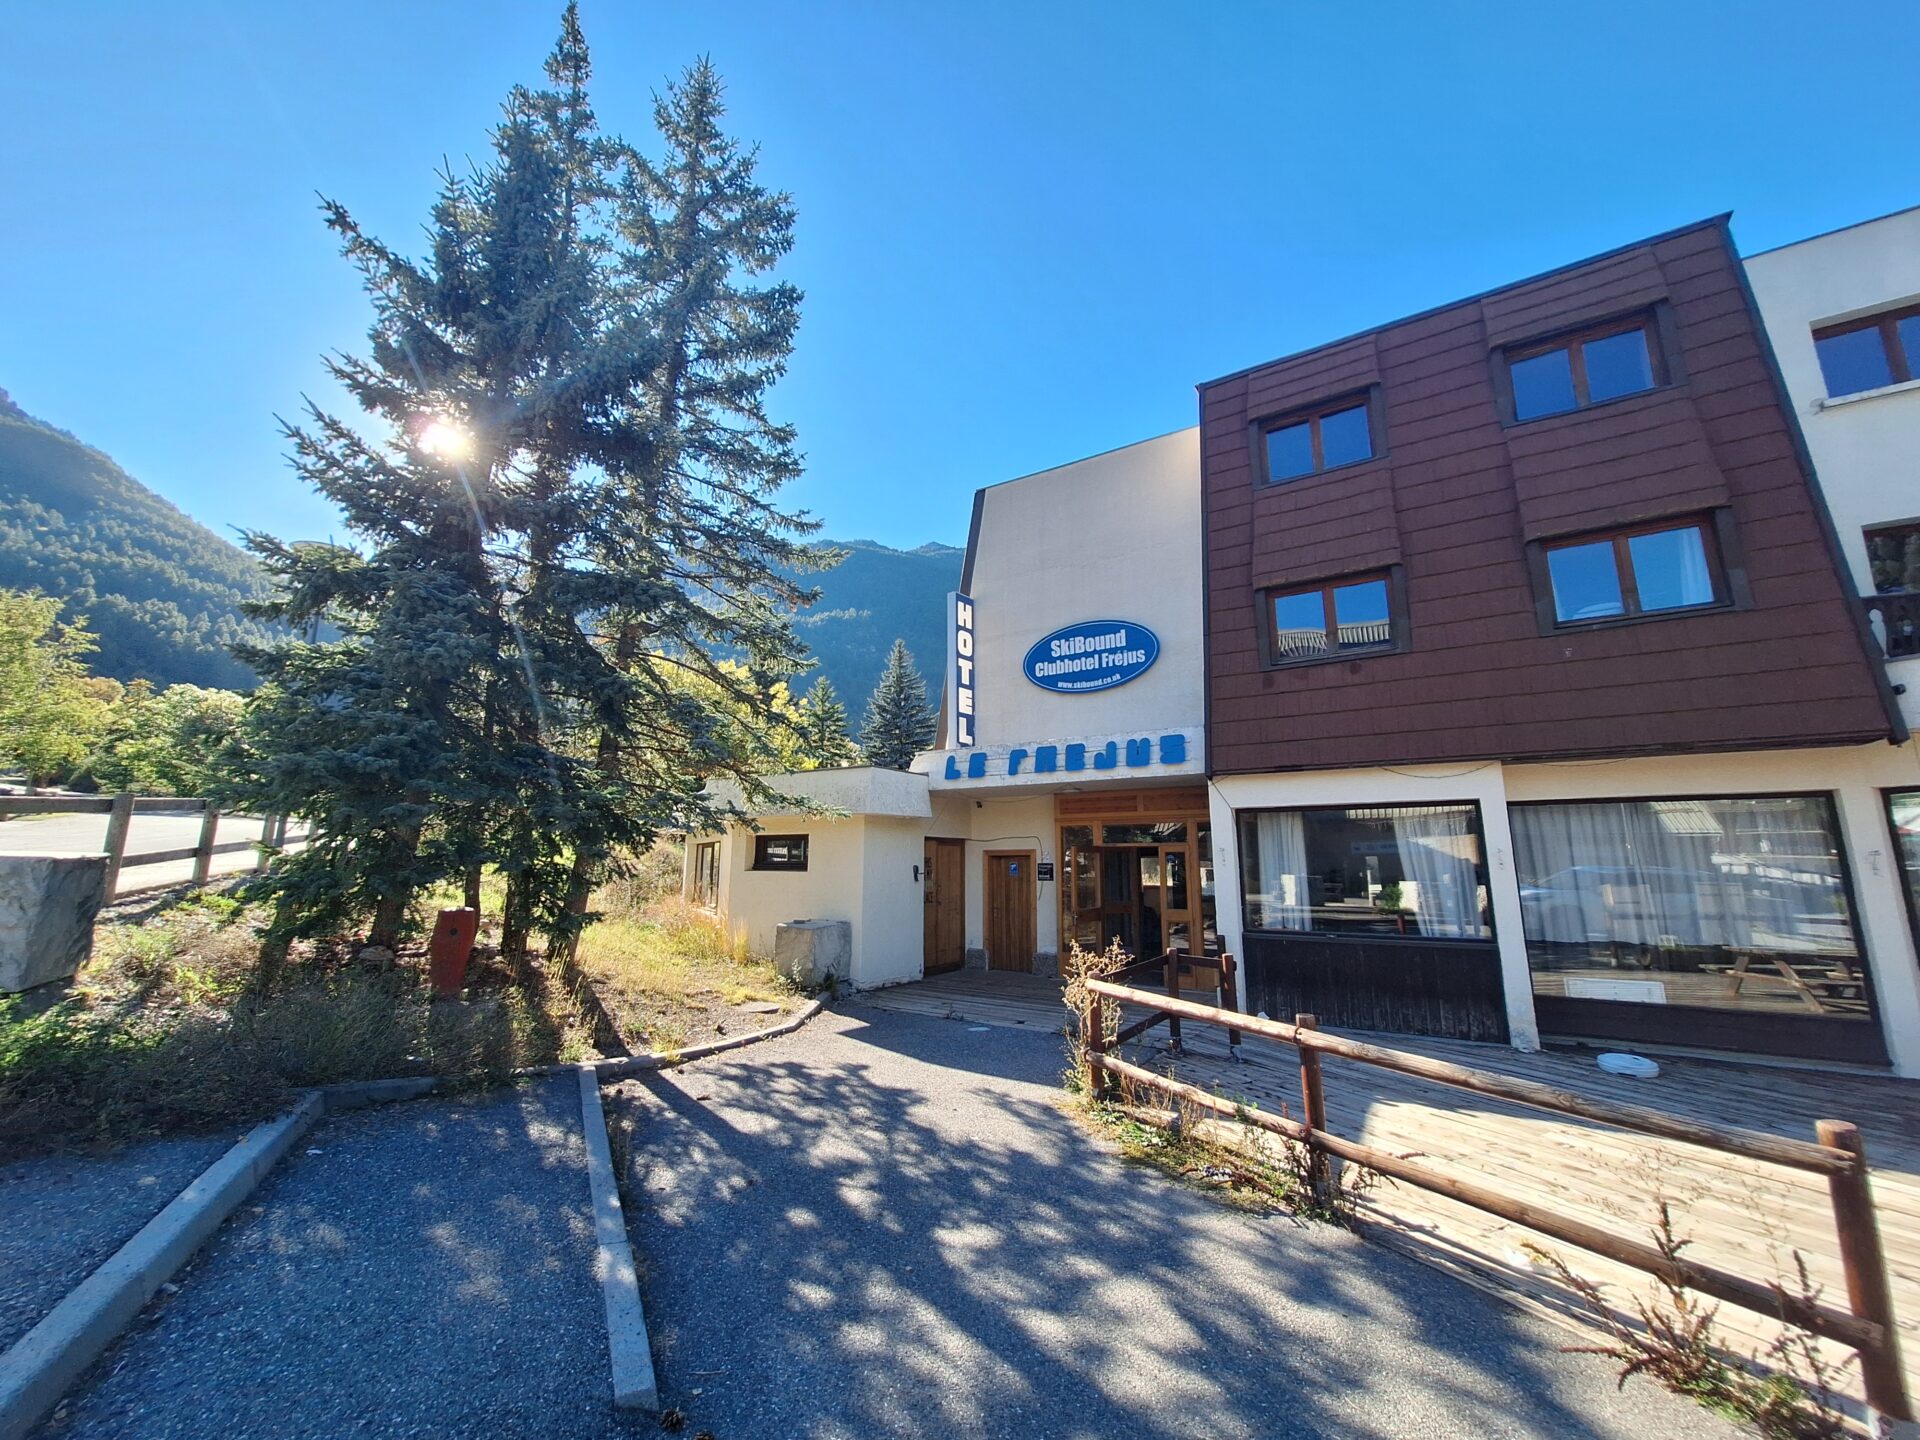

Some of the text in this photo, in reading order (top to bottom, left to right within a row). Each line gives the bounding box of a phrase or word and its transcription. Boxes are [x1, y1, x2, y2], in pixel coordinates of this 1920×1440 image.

[1050, 629, 1126, 658] SkiBound
[957, 600, 974, 746] HOTEL
[1035, 649, 1146, 678] Clubhotel Fréjus
[1057, 673, 1122, 689] www.skibound.co.uk
[944, 733, 1187, 780] LE FREJUS
